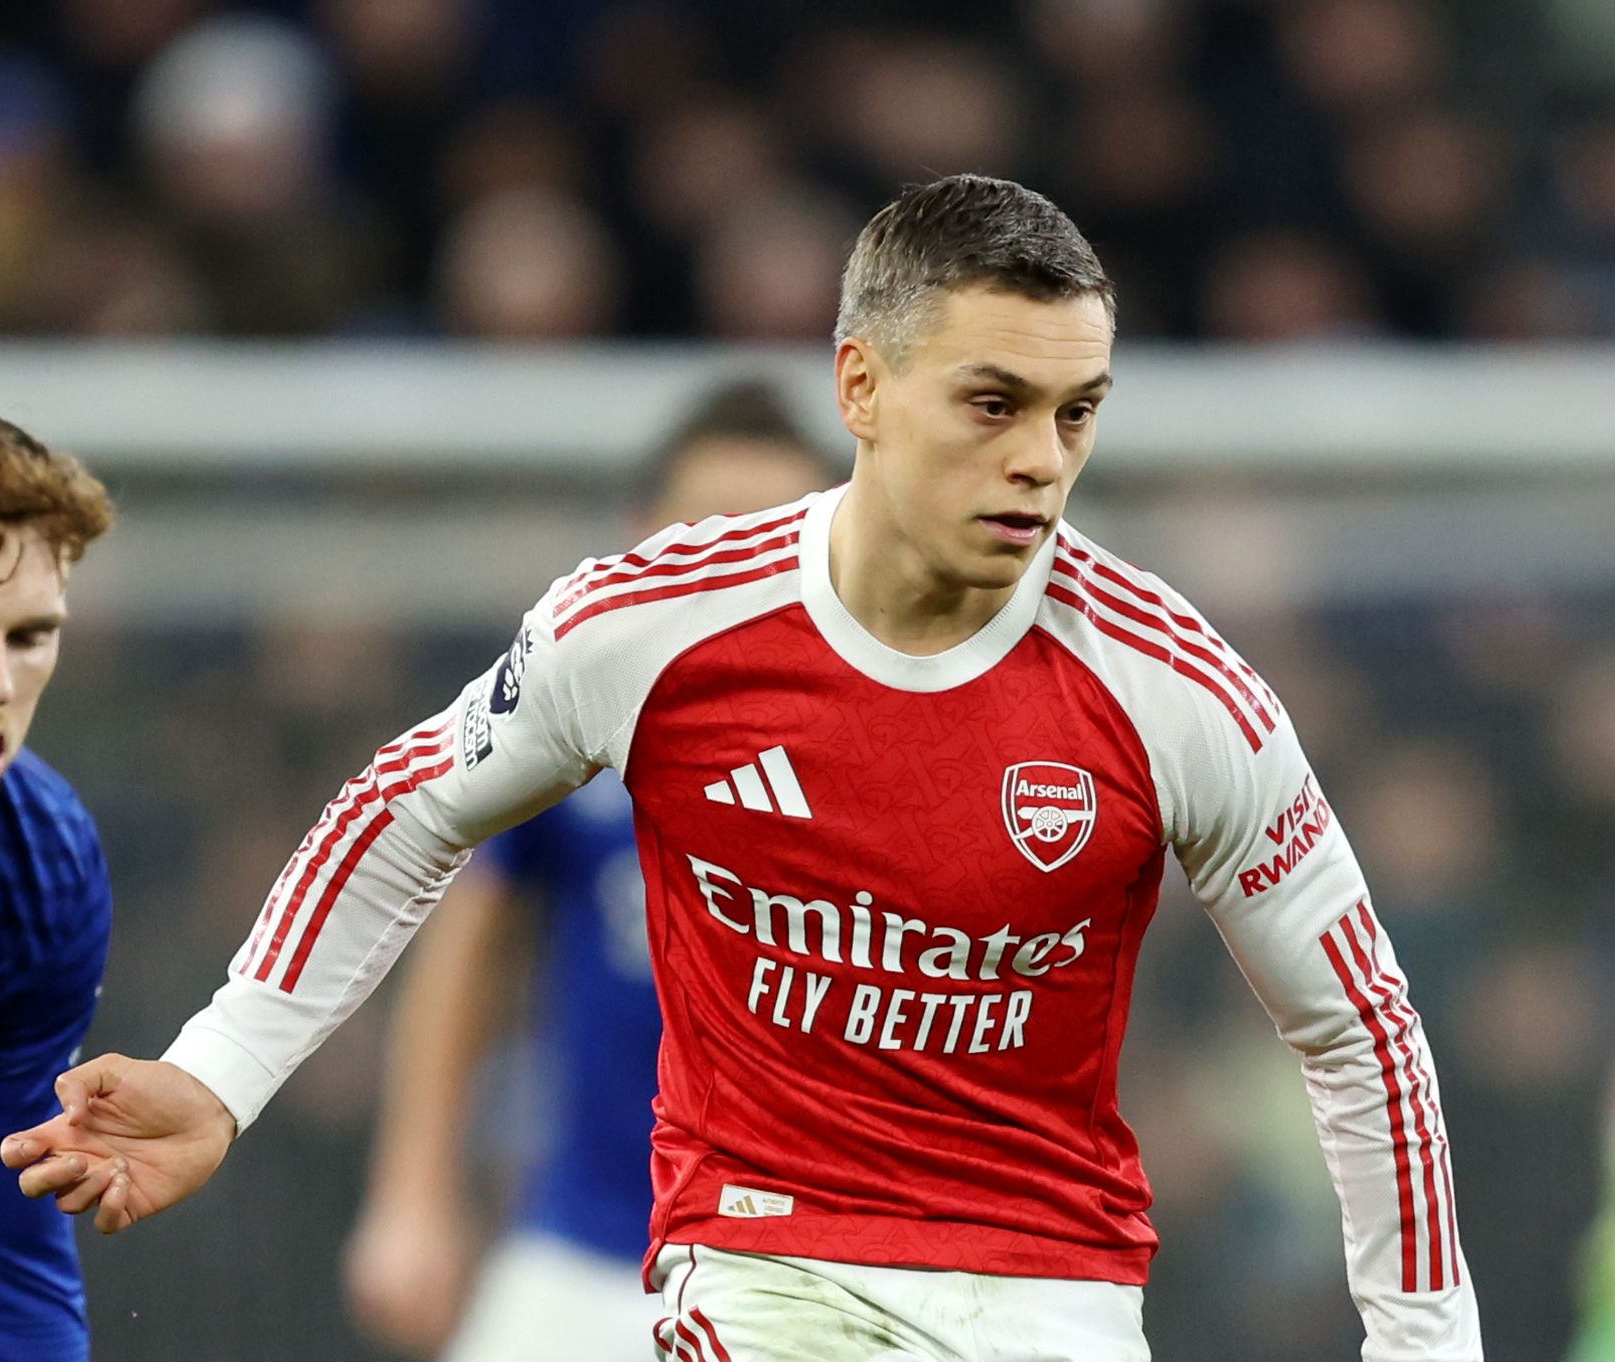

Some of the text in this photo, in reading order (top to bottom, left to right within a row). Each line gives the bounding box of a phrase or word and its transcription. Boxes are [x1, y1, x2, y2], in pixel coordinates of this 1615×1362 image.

[1016, 780, 1083, 800] Arsenal
[1265, 773, 1316, 846] VISIT
[1237, 797, 1330, 898] RWAND
[686, 853, 1092, 981] Emirates
[747, 957, 1034, 1055] FLY BETTER
